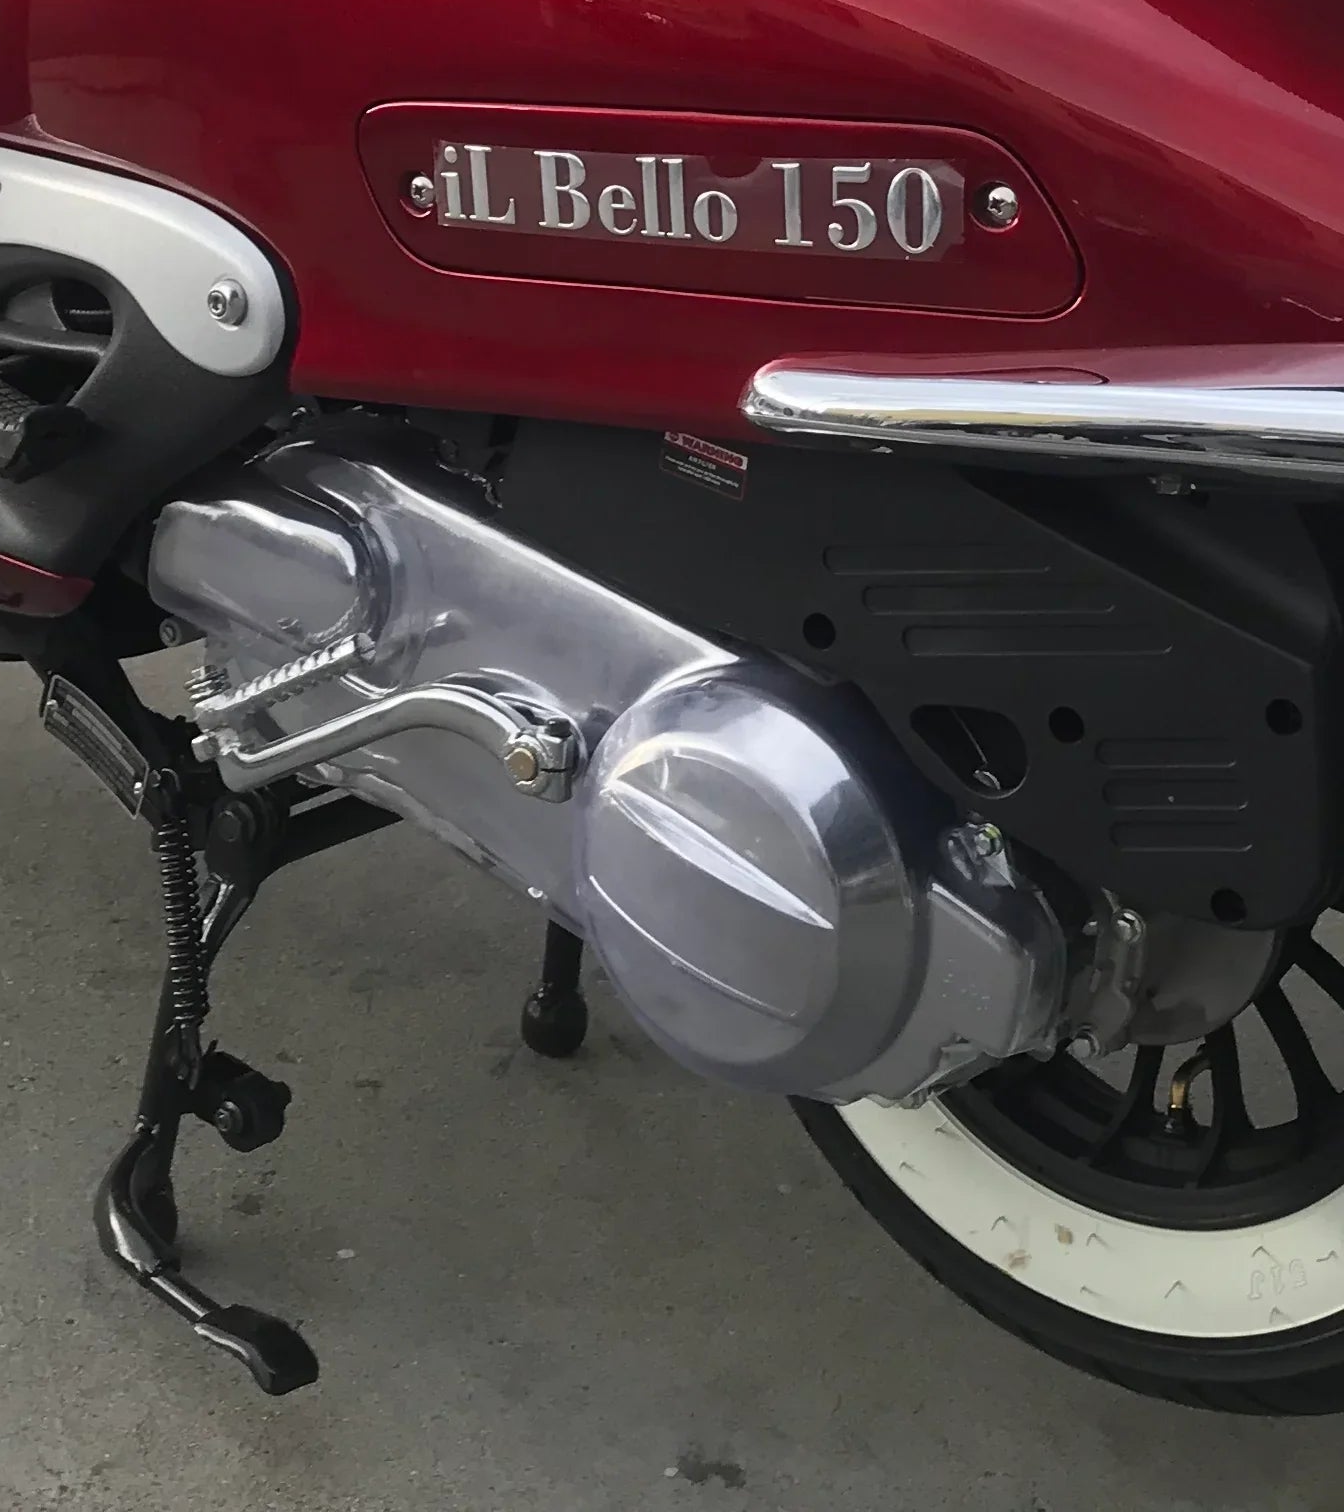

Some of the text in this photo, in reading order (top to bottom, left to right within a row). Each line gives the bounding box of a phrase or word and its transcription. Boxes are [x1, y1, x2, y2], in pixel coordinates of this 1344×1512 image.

[441, 144, 944, 255] iL Bello 150
[681, 435, 744, 469] WARNING
